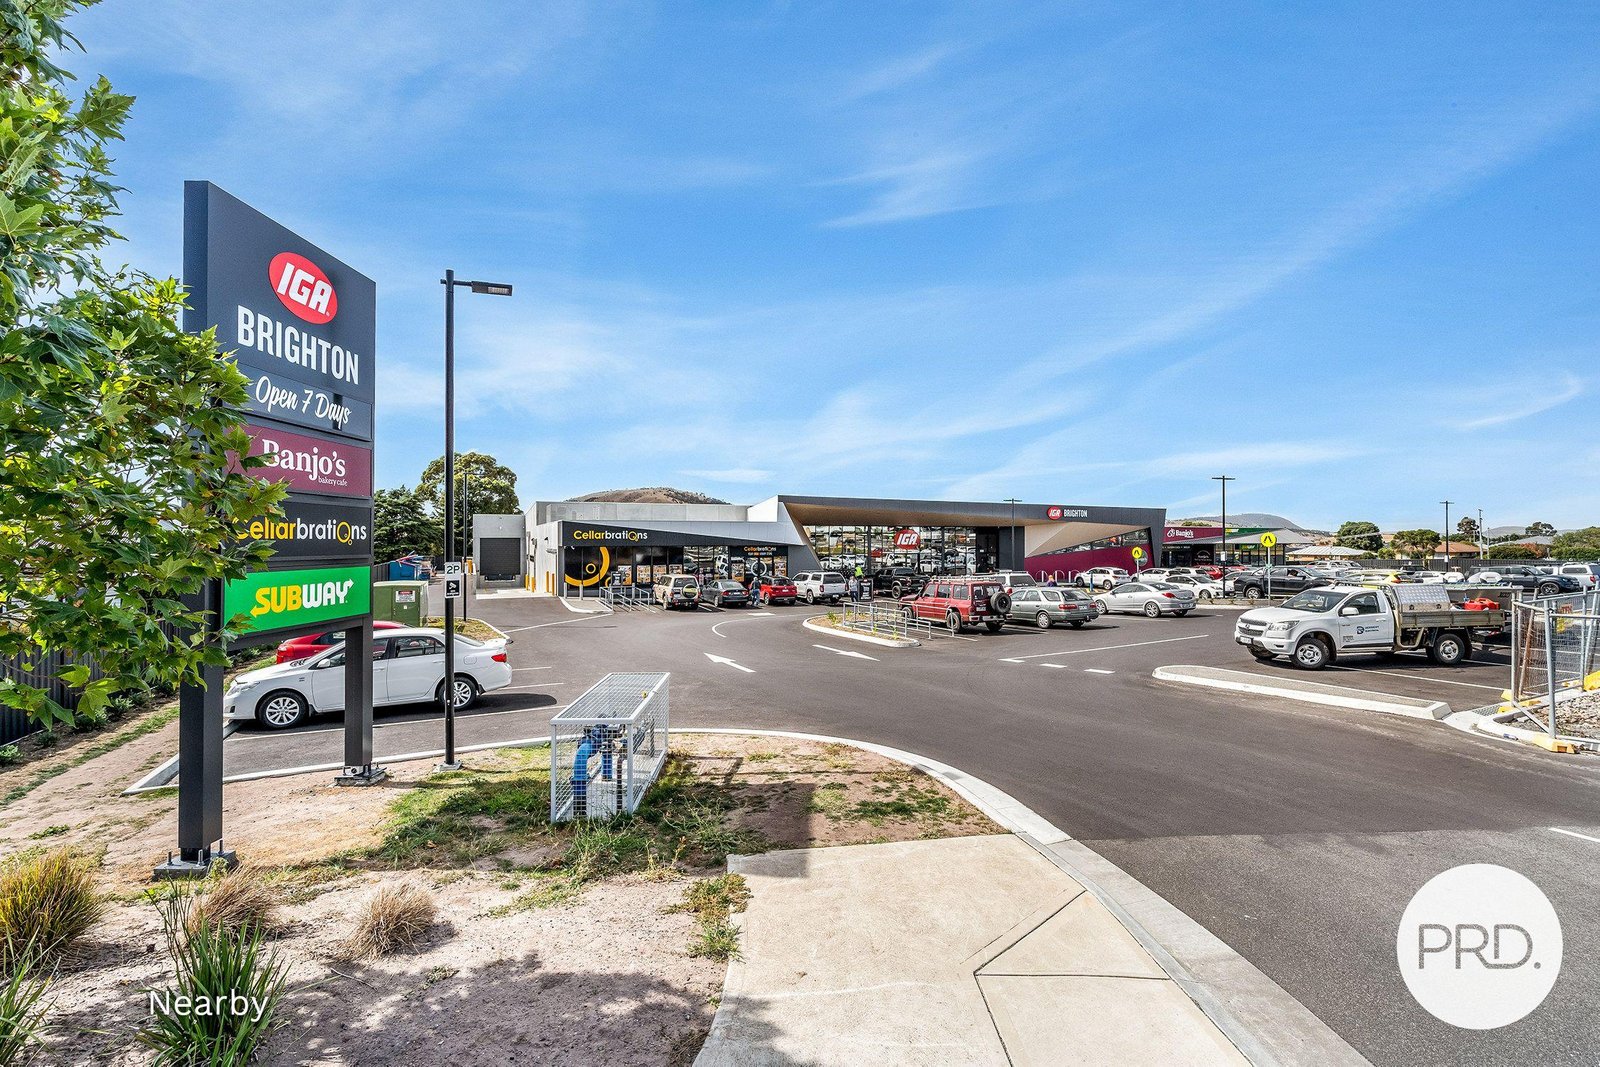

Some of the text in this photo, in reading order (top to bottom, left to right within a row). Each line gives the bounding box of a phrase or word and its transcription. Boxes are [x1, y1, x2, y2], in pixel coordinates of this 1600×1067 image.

[277, 262, 332, 315] IGA
[237, 304, 359, 385] BRIGHTON
[255, 375, 352, 430] Open 7 Days
[262, 439, 346, 480] Banjo's
[318, 475, 337, 486] bakery
[1049, 509, 1088, 518] IGA BRIGHTON
[896, 533, 918, 545] IGA
[446, 565, 460, 575] 2P
[250, 578, 355, 618] SUBWAY
